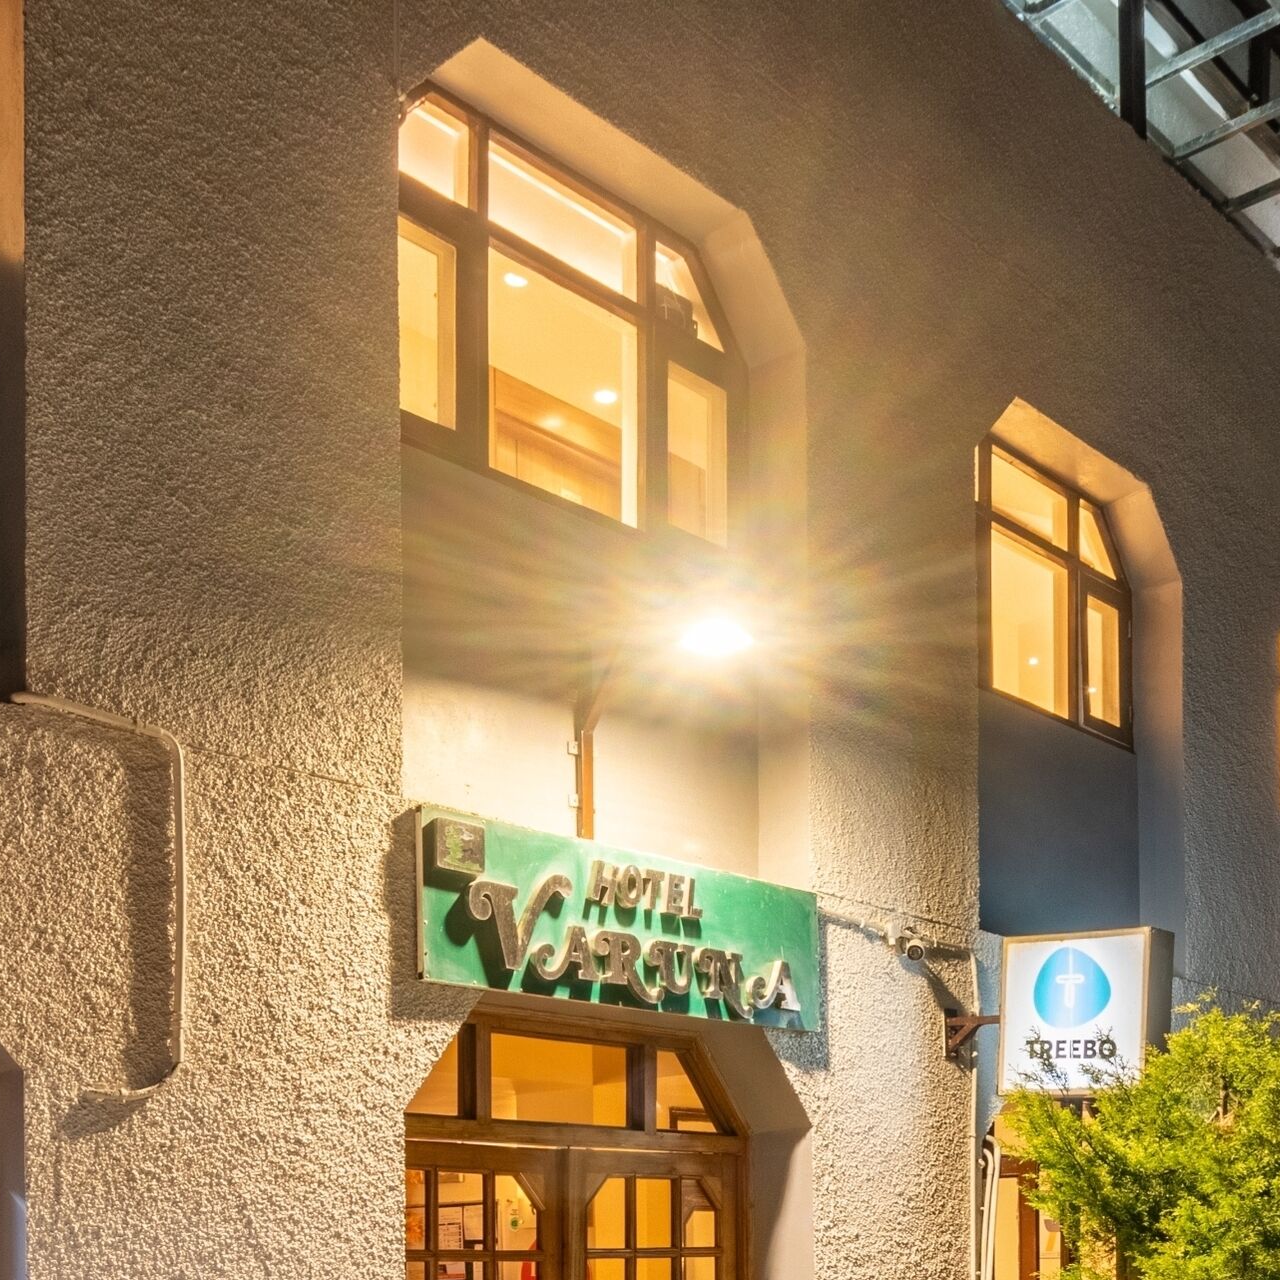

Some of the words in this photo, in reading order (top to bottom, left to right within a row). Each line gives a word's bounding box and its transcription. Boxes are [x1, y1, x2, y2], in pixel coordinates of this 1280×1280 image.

[589, 860, 703, 920] HOTEL
[468, 873, 802, 1020] VARUNA
[1025, 1039, 1117, 1059] TREEBO
